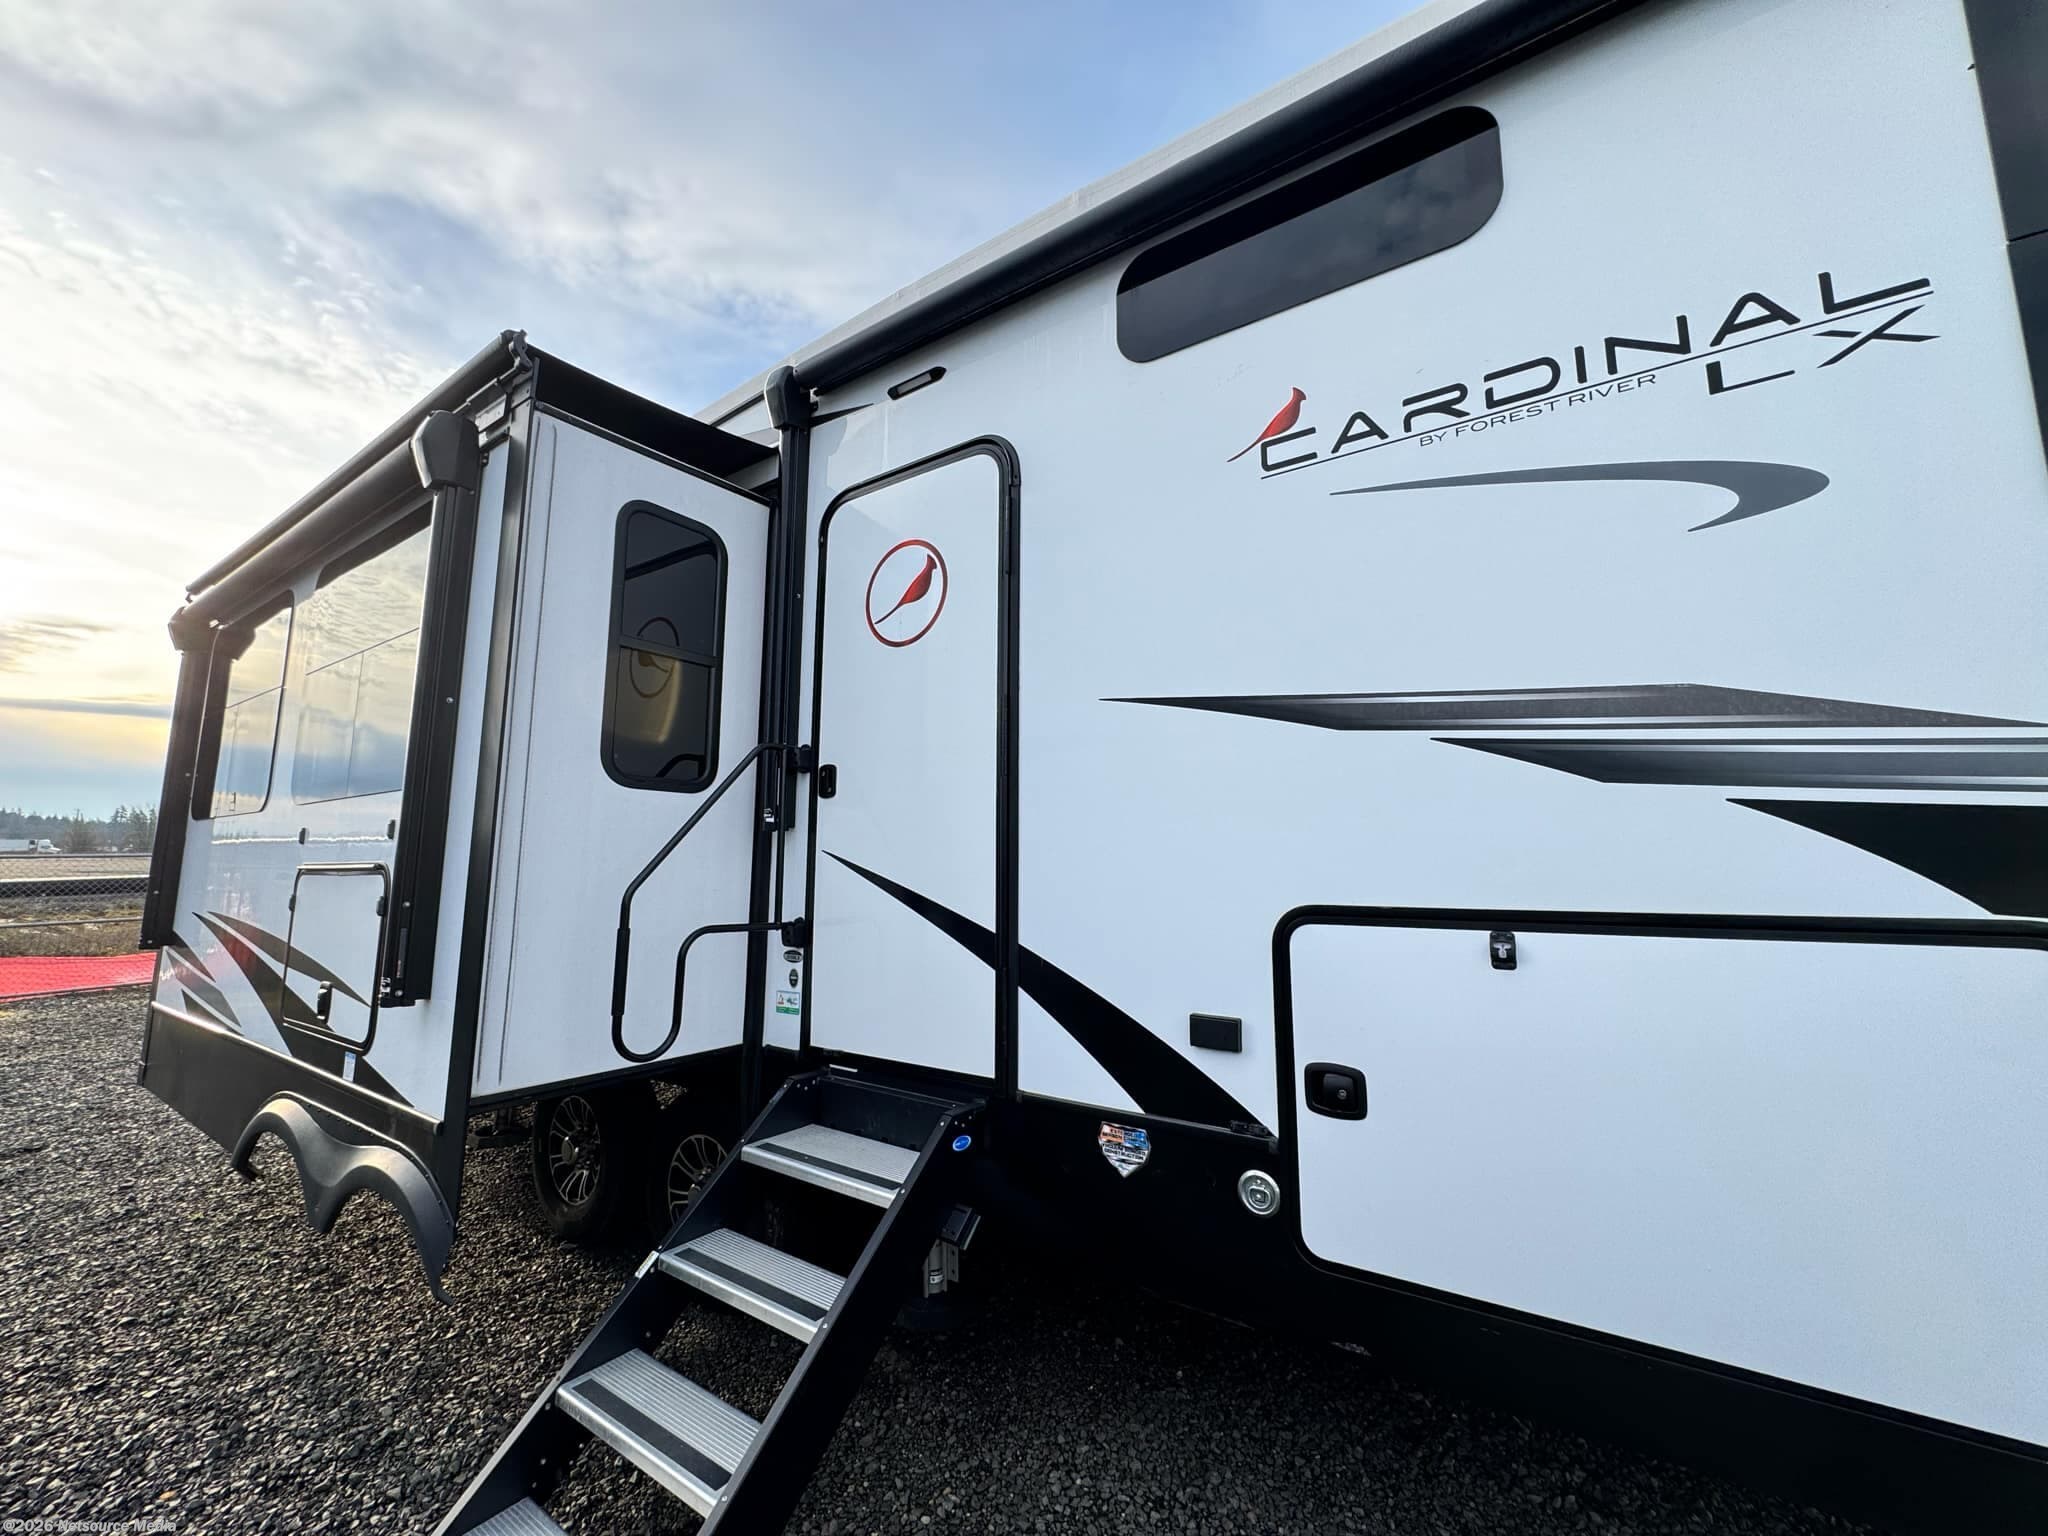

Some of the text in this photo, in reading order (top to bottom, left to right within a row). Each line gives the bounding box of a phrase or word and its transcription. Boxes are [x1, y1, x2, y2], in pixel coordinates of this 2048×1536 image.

[1261, 272, 1931, 472] CARDINAL
[1706, 304, 1942, 396] LX
[1419, 373, 1657, 447] BY FOREST RIVER
